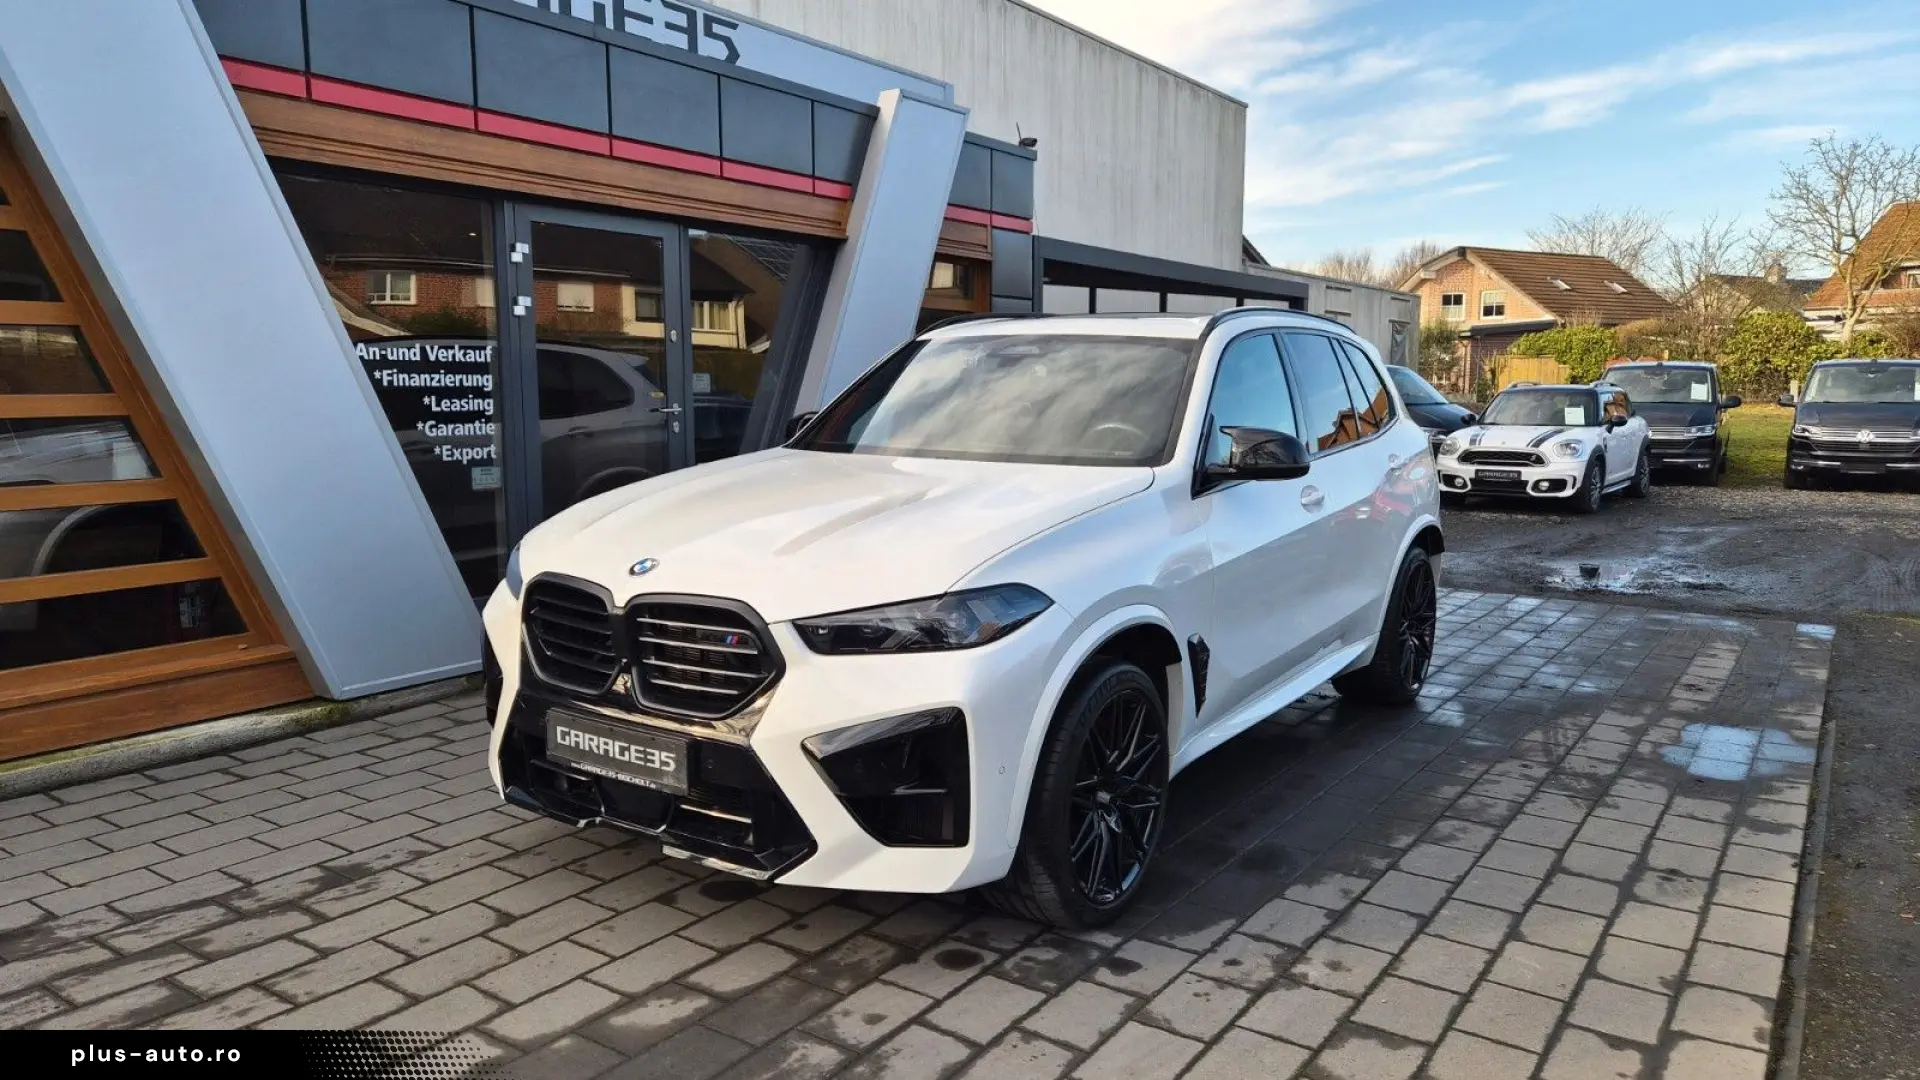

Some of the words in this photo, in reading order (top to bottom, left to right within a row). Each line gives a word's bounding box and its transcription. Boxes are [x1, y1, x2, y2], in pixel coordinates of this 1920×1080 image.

[355, 342, 421, 361] An-und
[425, 344, 493, 362] Verkauf
[556, 725, 677, 772] GARAGE35
